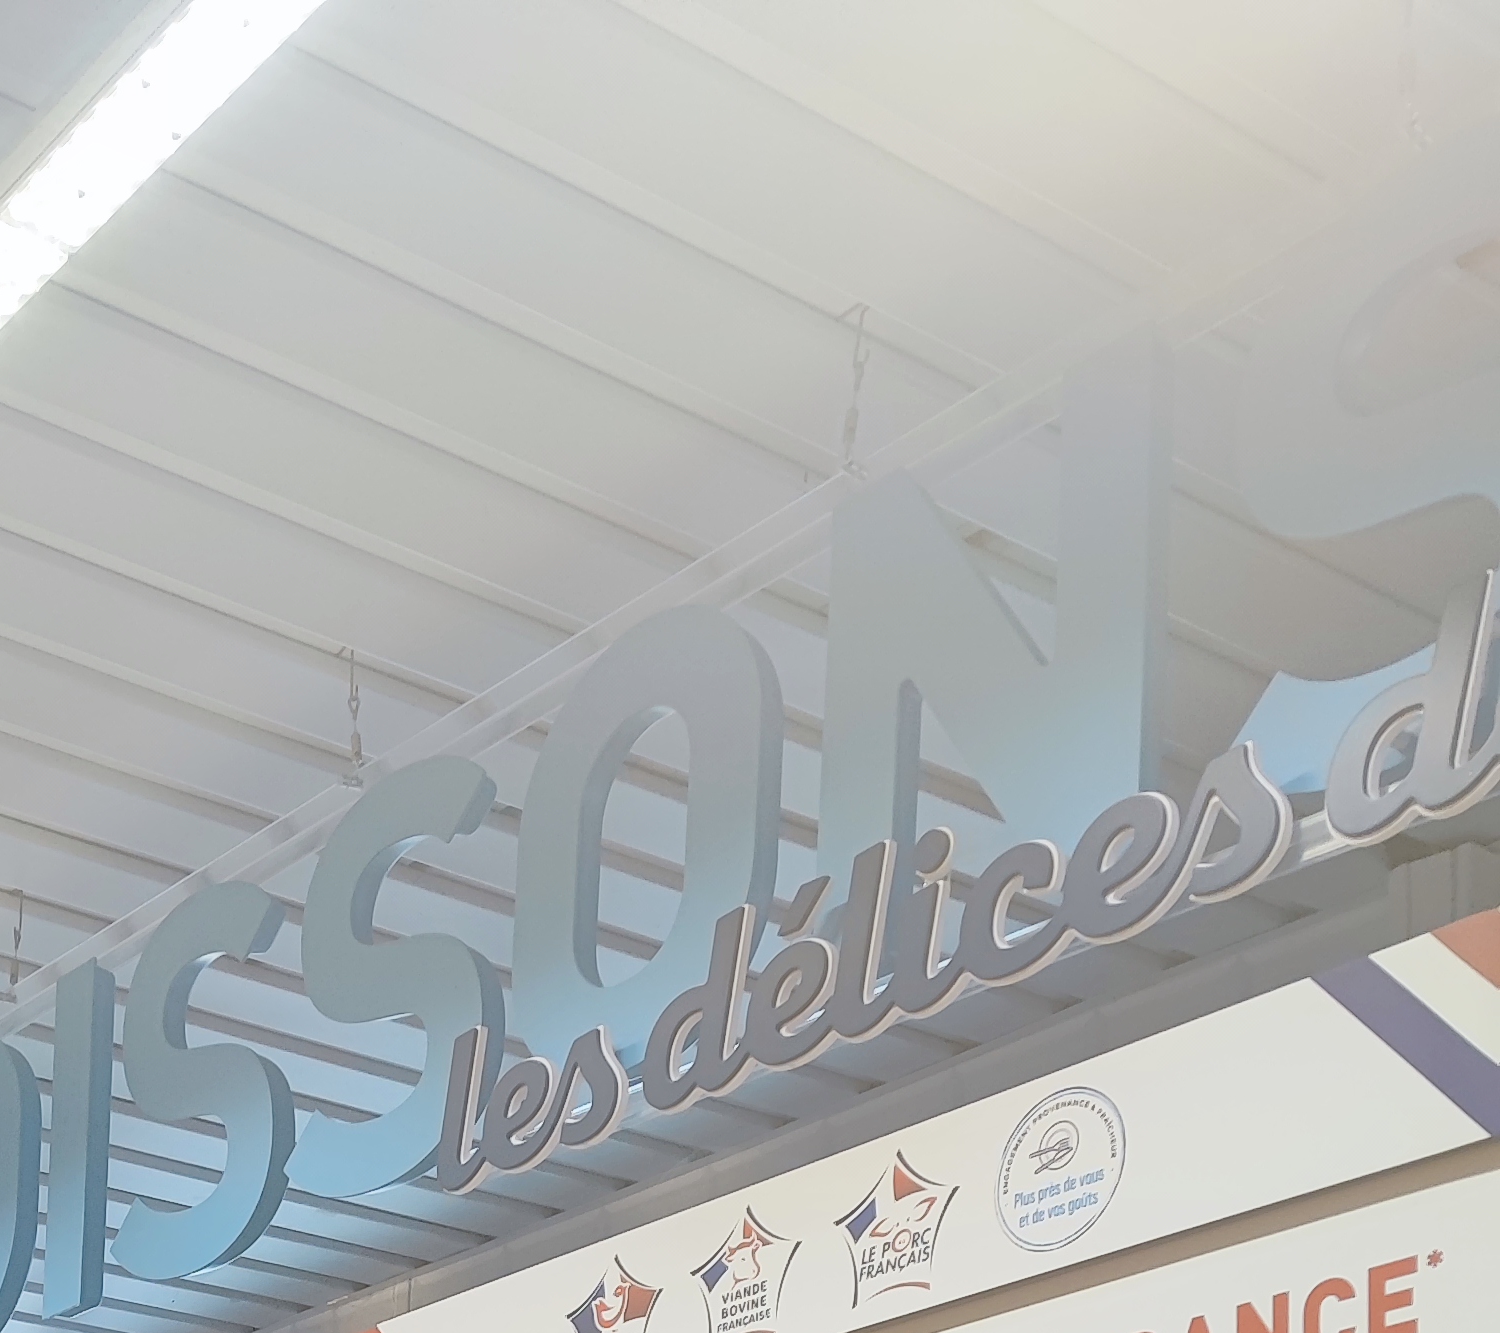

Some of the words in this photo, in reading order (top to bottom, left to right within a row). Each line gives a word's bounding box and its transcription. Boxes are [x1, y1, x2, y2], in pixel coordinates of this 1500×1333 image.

[437, 1022, 631, 1193] les
[642, 740, 1292, 1113] délices
[1014, 1190, 1035, 1209] Plus
[1038, 1181, 1061, 1204] près
[1064, 1176, 1076, 1191] de
[1080, 1168, 1105, 1187] vous
[1019, 1214, 1029, 1228] et
[1032, 1209, 1045, 1223] de
[1048, 1202, 1065, 1219] vos
[1068, 1192, 1099, 1216] goûts
[858, 1247, 931, 1283] FRANÇAIS
[862, 1246, 877, 1265] LE
[721, 1279, 768, 1305] VIANDE
[721, 1294, 767, 1319] BOVINE
[717, 1307, 771, 1333] FRANÇAISE
